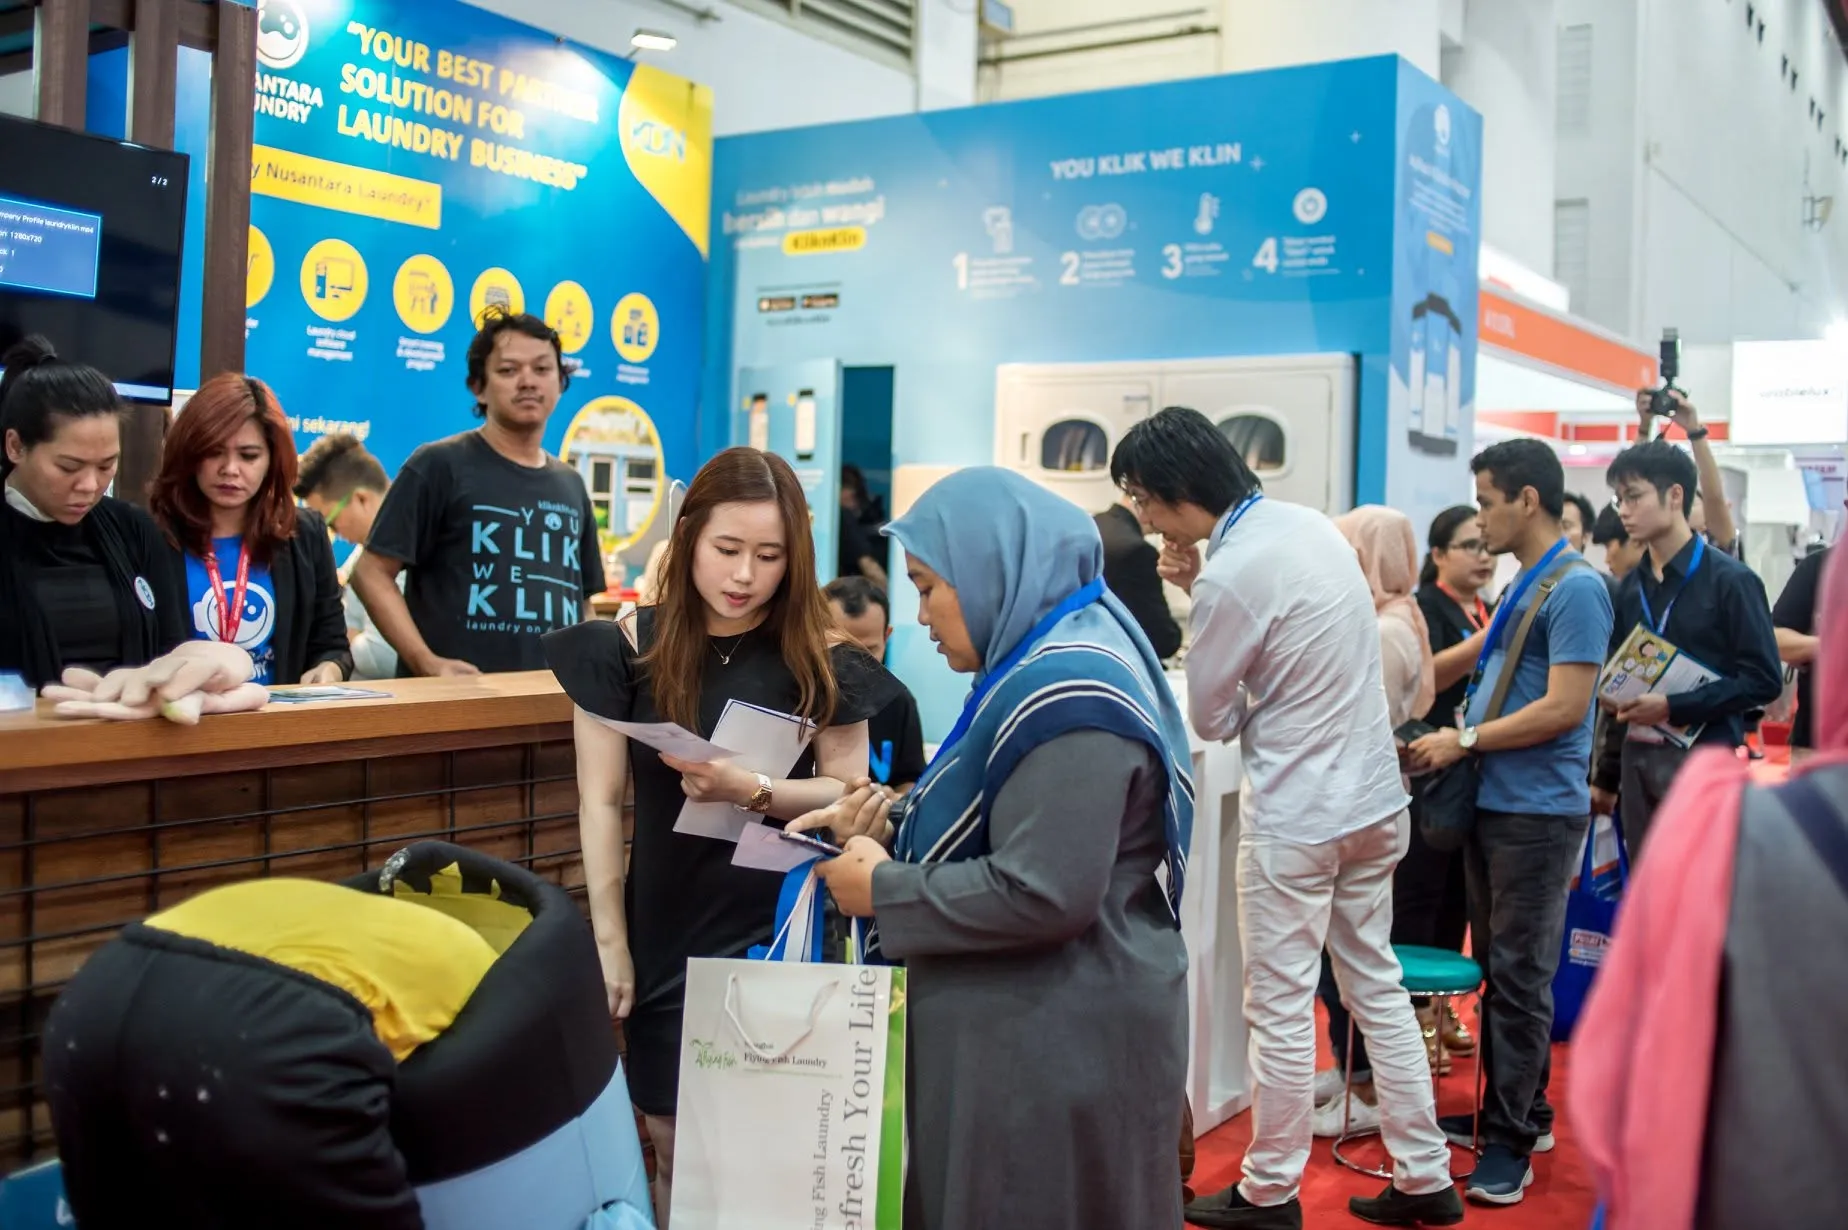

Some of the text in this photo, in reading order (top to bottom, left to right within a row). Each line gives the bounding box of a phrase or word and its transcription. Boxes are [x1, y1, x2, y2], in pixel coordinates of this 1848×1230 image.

[437, 50, 494, 90] BEST
[340, 63, 525, 139] SOLUTION FOR
[338, 105, 464, 160] LAUNDRY
[266, 162, 352, 194] Nusantara
[1050, 142, 1242, 181] YOU KLIK WE KLIN
[10, 231, 43, 244] 1280x720
[1253, 237, 1278, 274] 4
[953, 252, 968, 290] 1
[1059, 251, 1080, 285] 2
[1161, 244, 1184, 279] 3
[472, 520, 580, 571] KLIK
[472, 562, 523, 584] WE
[467, 583, 578, 626] KLIN
[466, 619, 521, 634] laundry
[526, 624, 541, 633] on
[849, 968, 878, 1031] Life
[792, 1056, 827, 1069] Laundry
[843, 1041, 872, 1121] Your
[814, 1088, 834, 1160] Laundry
[812, 1165, 826, 1201] Fish
